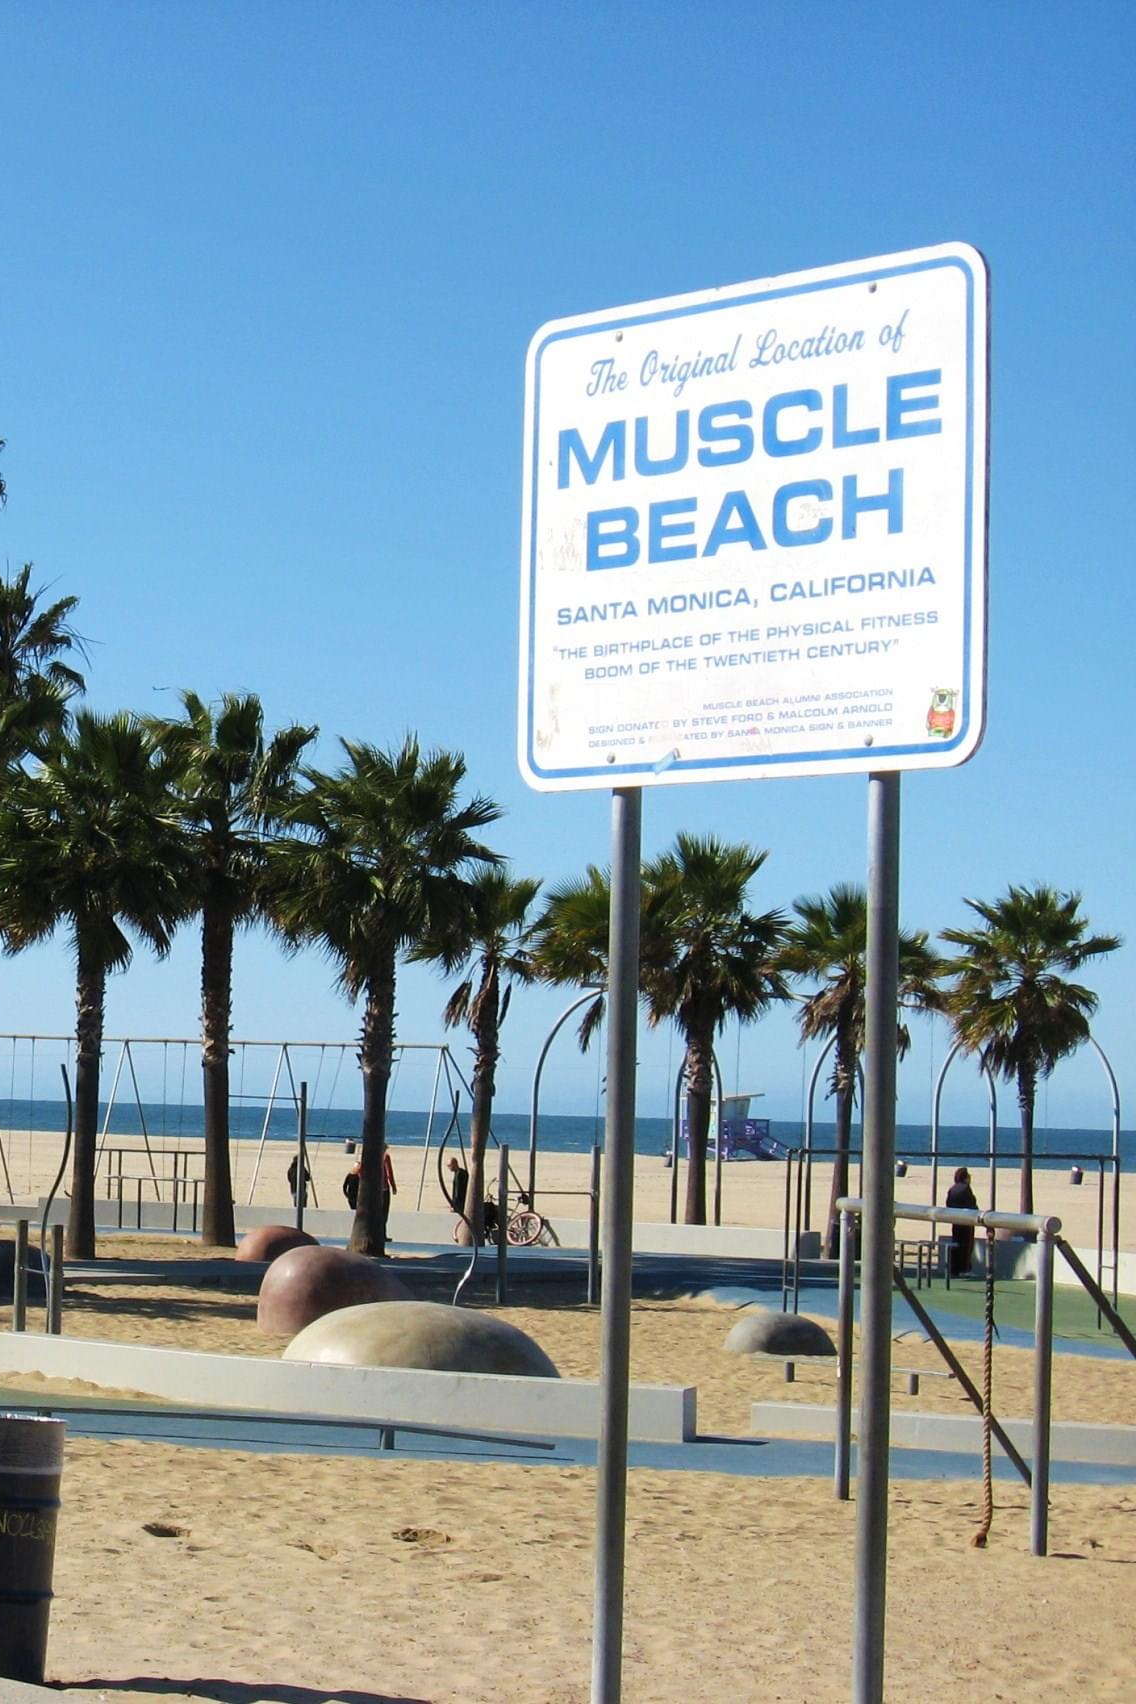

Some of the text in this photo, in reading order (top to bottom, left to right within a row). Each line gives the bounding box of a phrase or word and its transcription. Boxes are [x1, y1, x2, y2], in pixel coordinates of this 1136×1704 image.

[586, 308, 910, 398] The Original Location of
[557, 367, 942, 490] MUSCLE
[586, 467, 904, 572] BEACH
[557, 566, 936, 626] SANTA MONICA, CALIFORNIA
[593, 636, 693, 657] BIRTHPLACE
[699, 632, 722, 646] OF
[727, 628, 761, 644] THE
[766, 619, 854, 640] PHYSICAL
[861, 610, 939, 630] FITNESS
[584, 664, 633, 680] BOOM
[639, 661, 661, 675] OF
[666, 658, 698, 672] THE
[703, 648, 800, 669] TWENTIETH
[588, 724, 614, 735] SIGN
[672, 718, 688, 728] BY
[691, 715, 728, 726] STEVE
[731, 712, 763, 723] FORD
[766, 711, 775, 720] &
[778, 707, 838, 720] MALCOLM
[842, 702, 893, 715] ARNOLD
[702, 688, 894, 711] MUSCLE BEACH ALUMNI ASSOCIATION
[588, 737, 636, 748] DESIGNED
[710, 730, 723, 739] BY
[764, 724, 806, 735] MONICA
[808, 721, 834, 732] SIGN
[847, 718, 893, 729] BANNER
